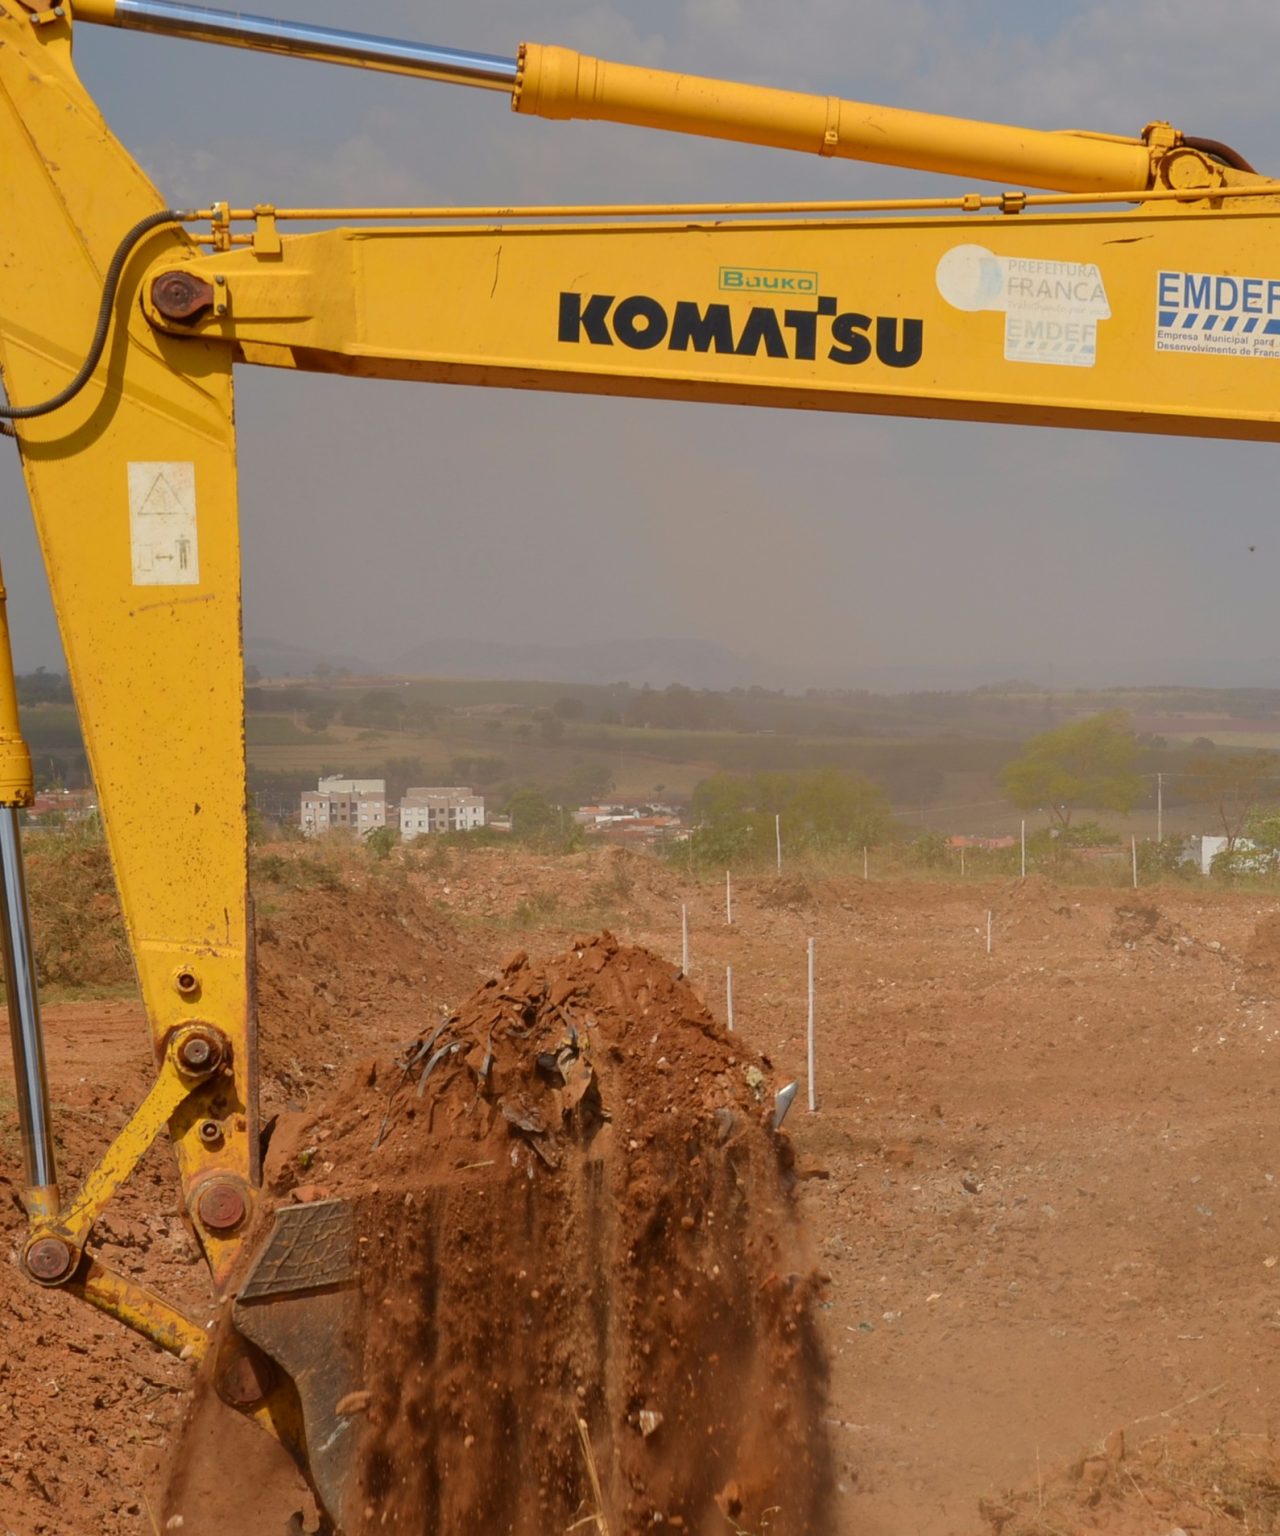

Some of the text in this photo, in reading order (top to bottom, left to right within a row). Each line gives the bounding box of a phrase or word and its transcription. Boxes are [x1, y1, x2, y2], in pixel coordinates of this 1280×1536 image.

[1008, 259, 1098, 278] PREFEITURA
[1007, 276, 1107, 303] FRANCA
[558, 292, 923, 368] KOMATSU
[1007, 318, 1096, 343] EMDEF
[1157, 330, 1199, 341] Empresa
[1203, 333, 1249, 345] Municipal
[1253, 337, 1274, 347] para
[1157, 341, 1239, 355] Desenvolvimento
[1239, 346, 1251, 356] de
